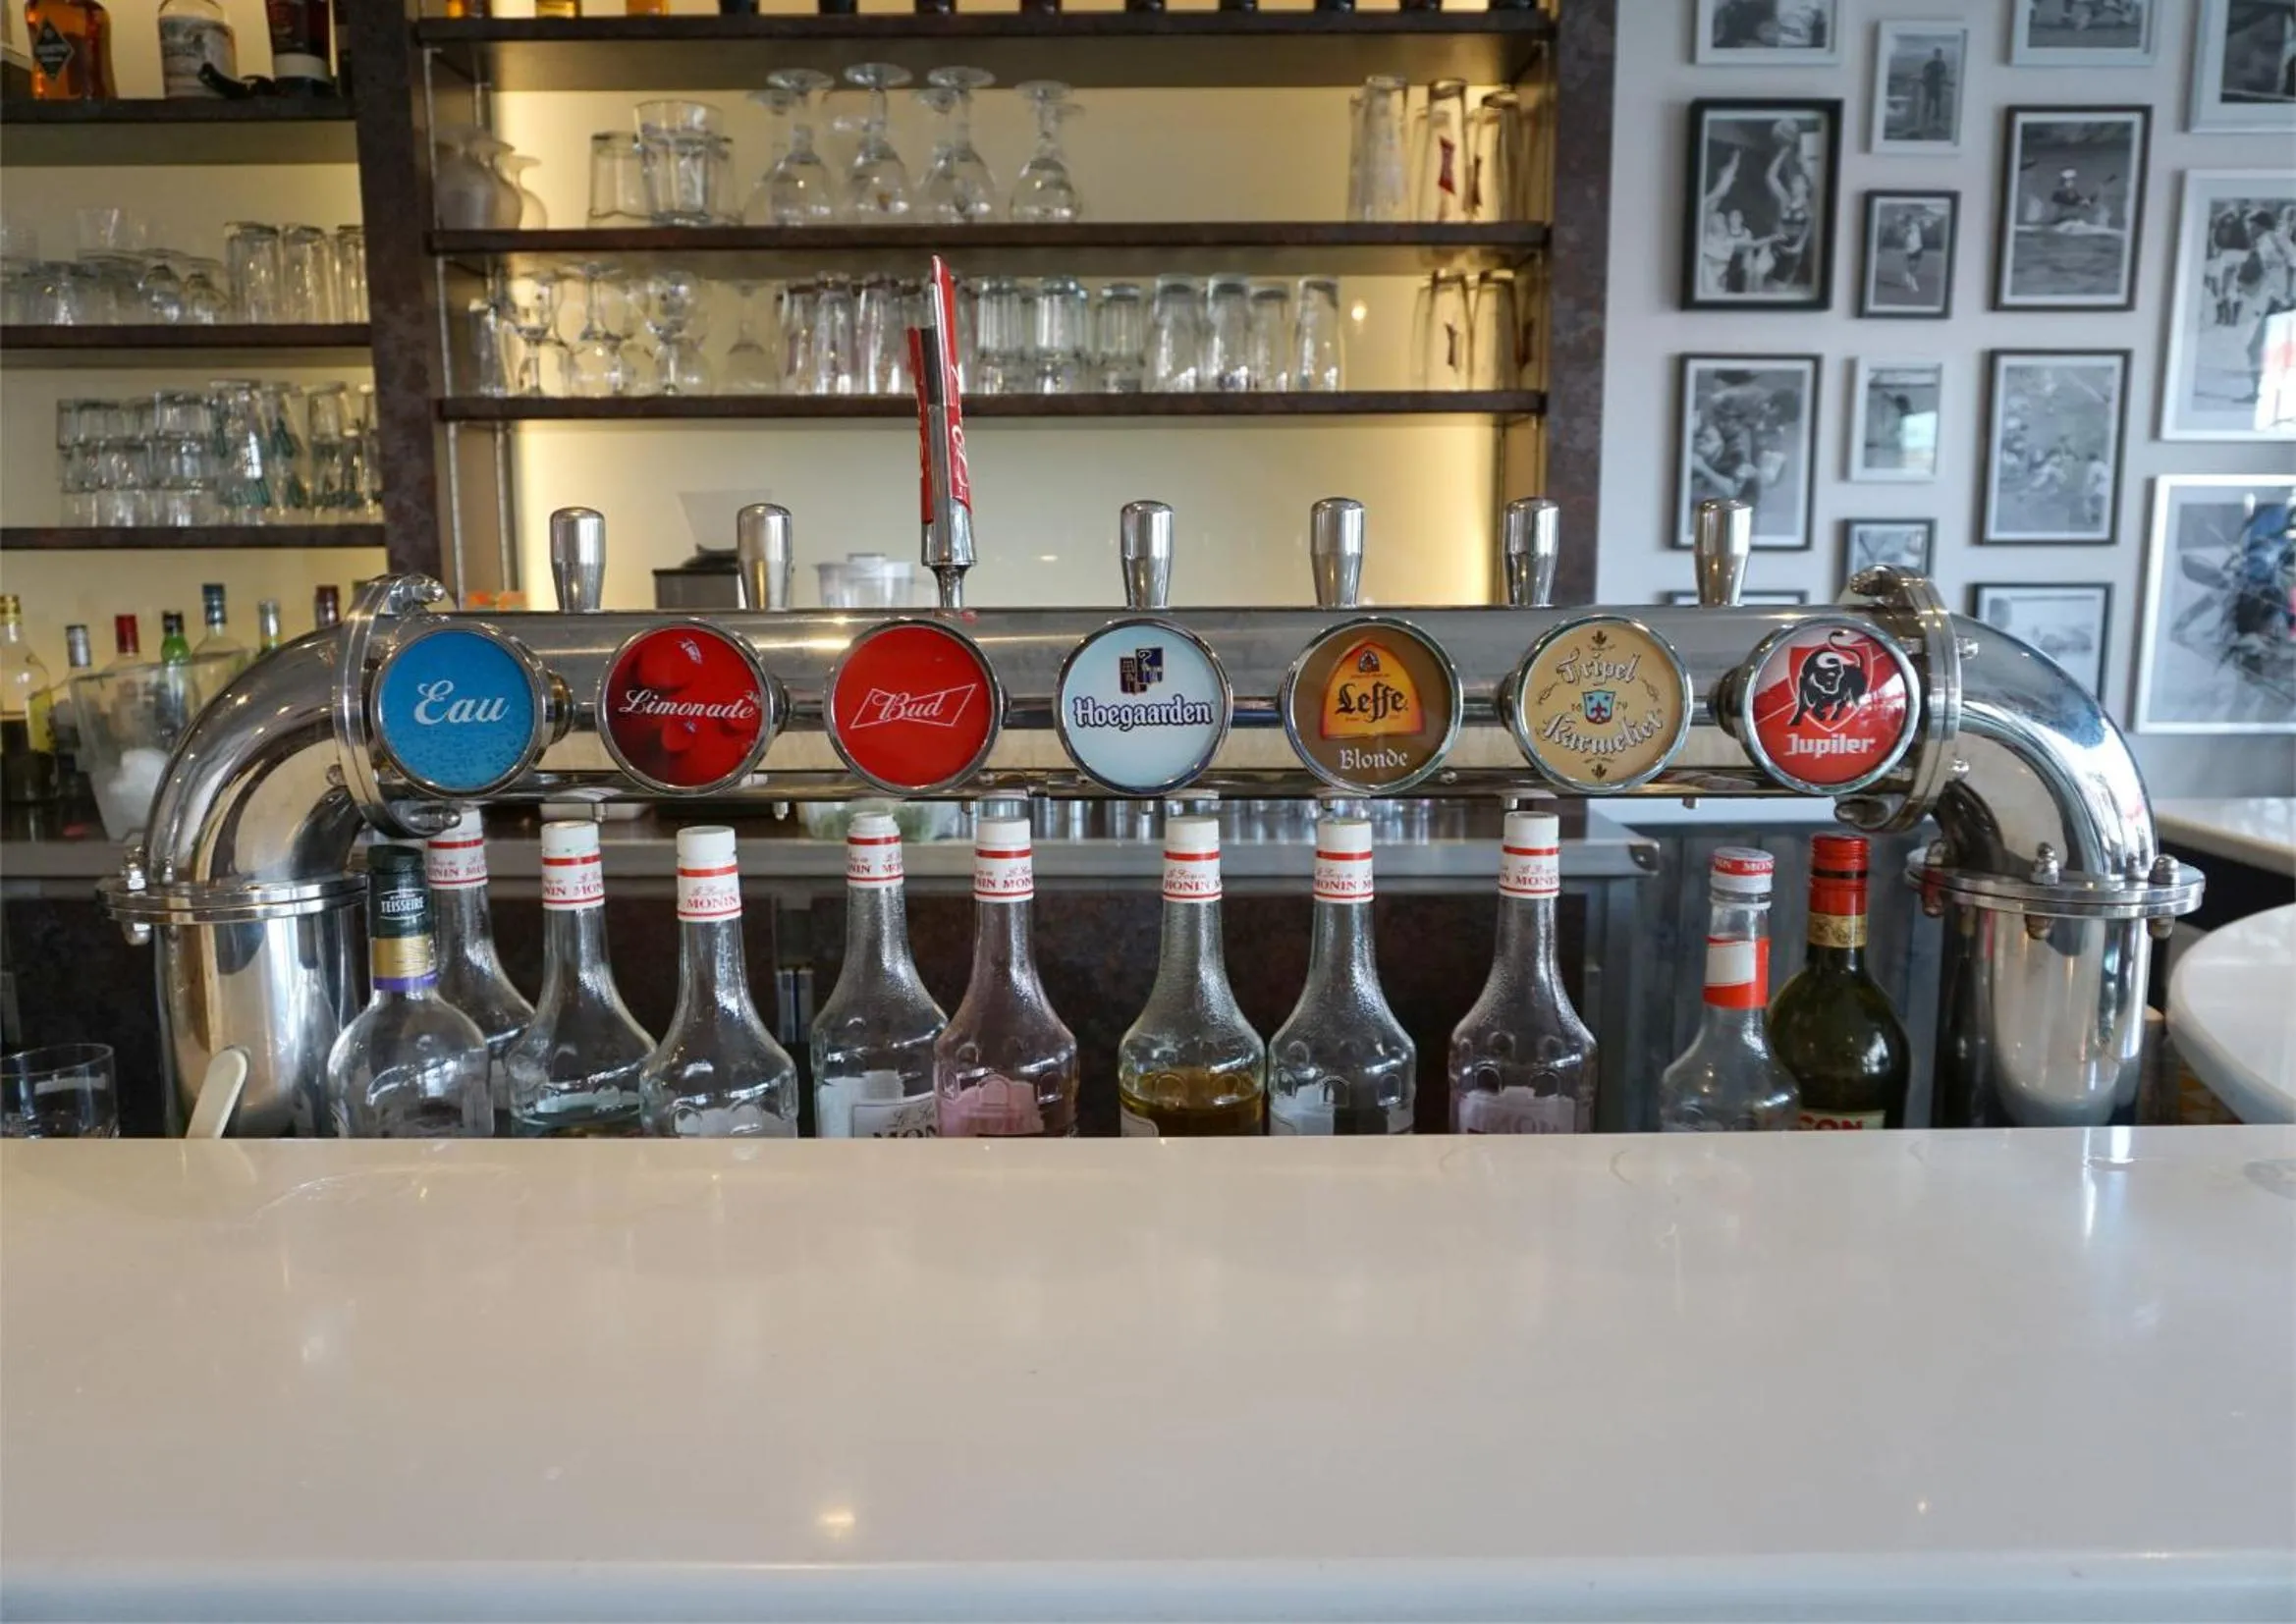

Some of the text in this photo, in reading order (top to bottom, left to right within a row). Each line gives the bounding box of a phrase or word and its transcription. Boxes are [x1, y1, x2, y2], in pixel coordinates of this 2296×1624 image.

[1557, 647, 1641, 685] Tripel
[414, 679, 510, 725] Eau
[619, 689, 755, 719] Limonade
[873, 692, 946, 721] Bud
[1073, 693, 1213, 732] Hoegaarden
[1336, 681, 1407, 724] Leffe
[1536, 708, 1663, 754] Karmeliet
[1783, 733, 1876, 758] Jupiler
[1339, 748, 1408, 770] Blonde
